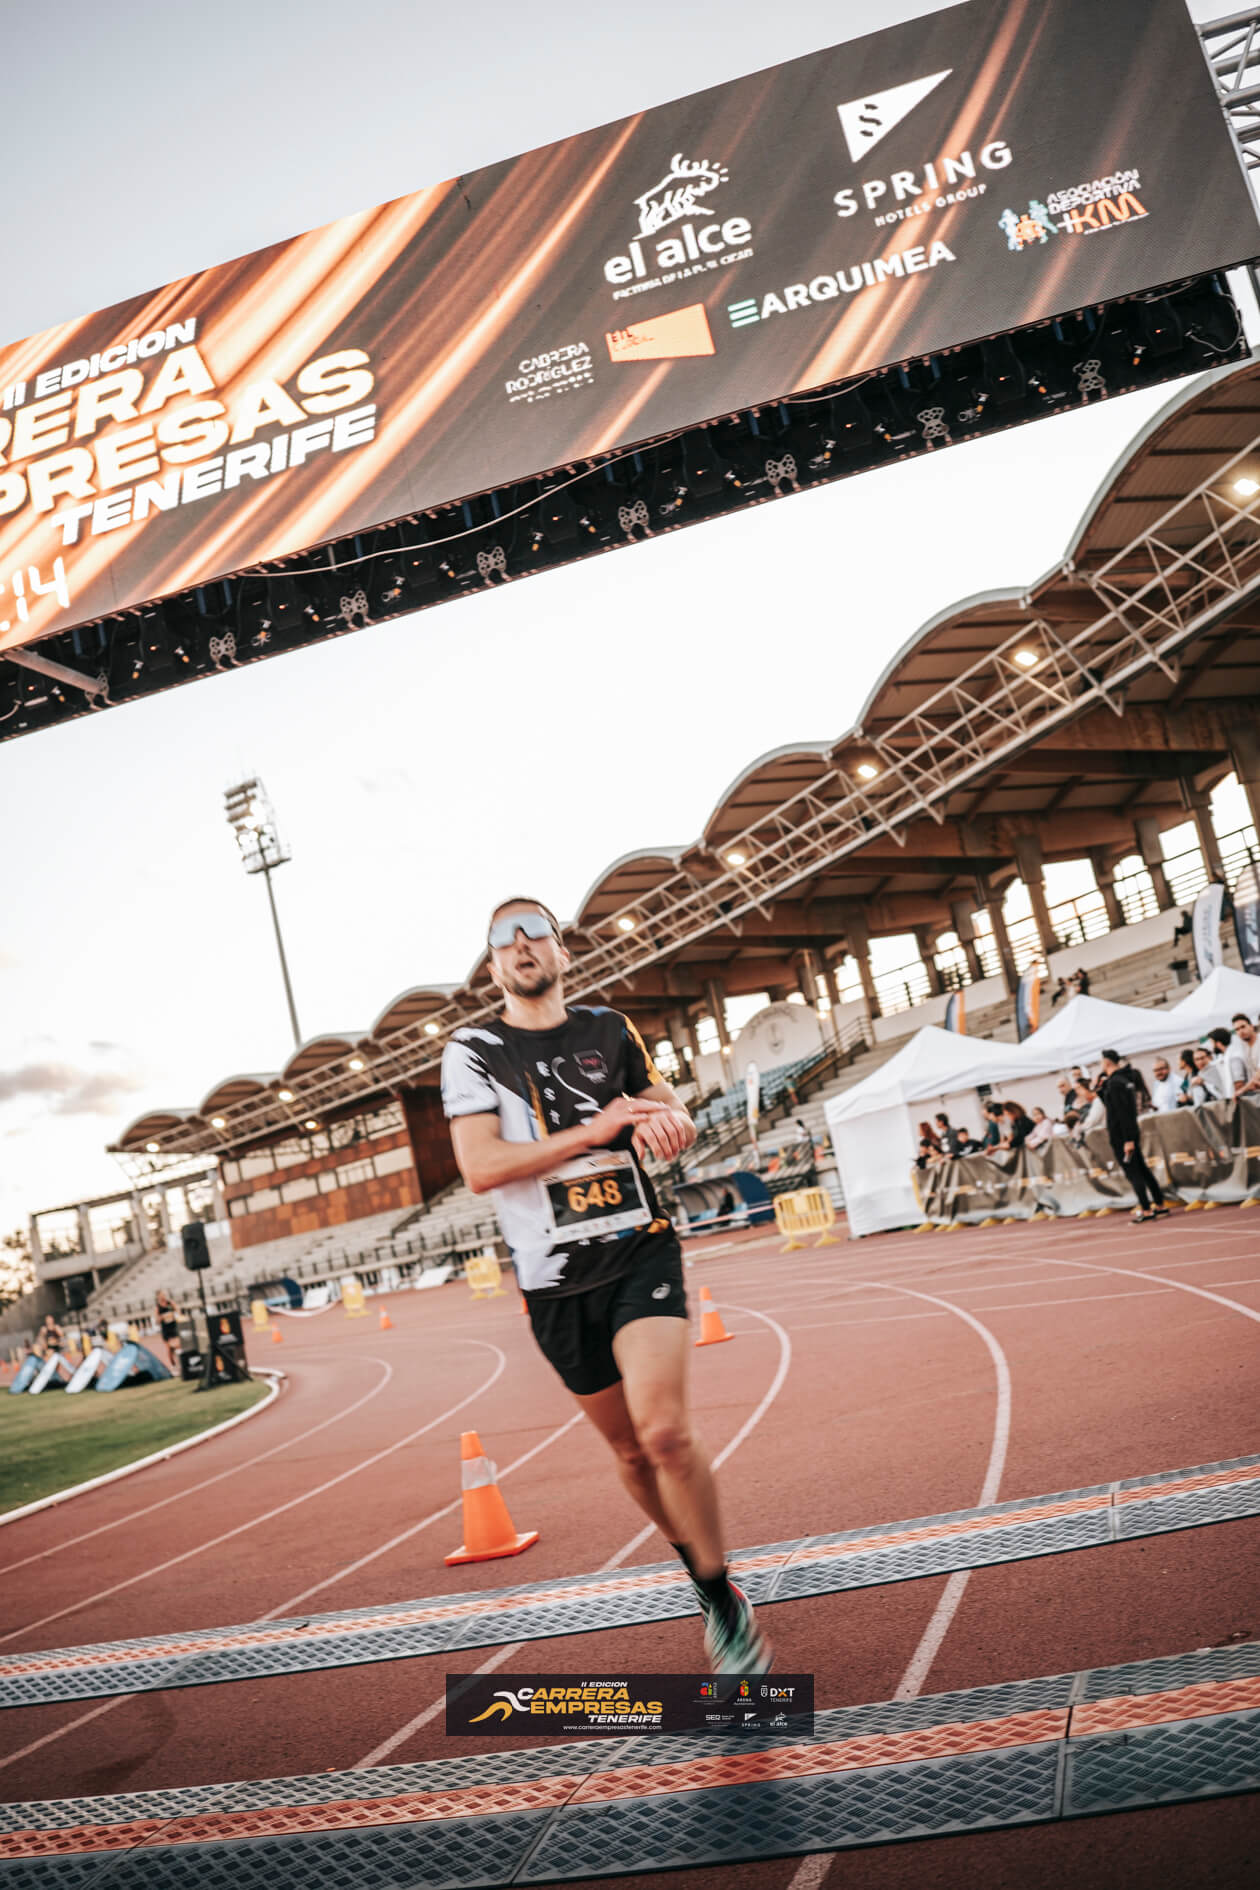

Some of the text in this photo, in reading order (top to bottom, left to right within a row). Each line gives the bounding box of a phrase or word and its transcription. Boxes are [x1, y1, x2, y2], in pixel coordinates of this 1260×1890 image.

[834, 141, 1012, 217] SPRING
[875, 184, 988, 227] HOTELS GROUP
[1047, 179, 1142, 215] DEPORTIVA
[604, 241, 646, 284] el
[655, 216, 752, 268] alce
[761, 240, 956, 320] ARQUIMEA
[34, 317, 197, 399] EDICION
[0, 345, 216, 464] ERA
[50, 404, 377, 546] TENERIFE
[567, 1179, 623, 1213] 648
